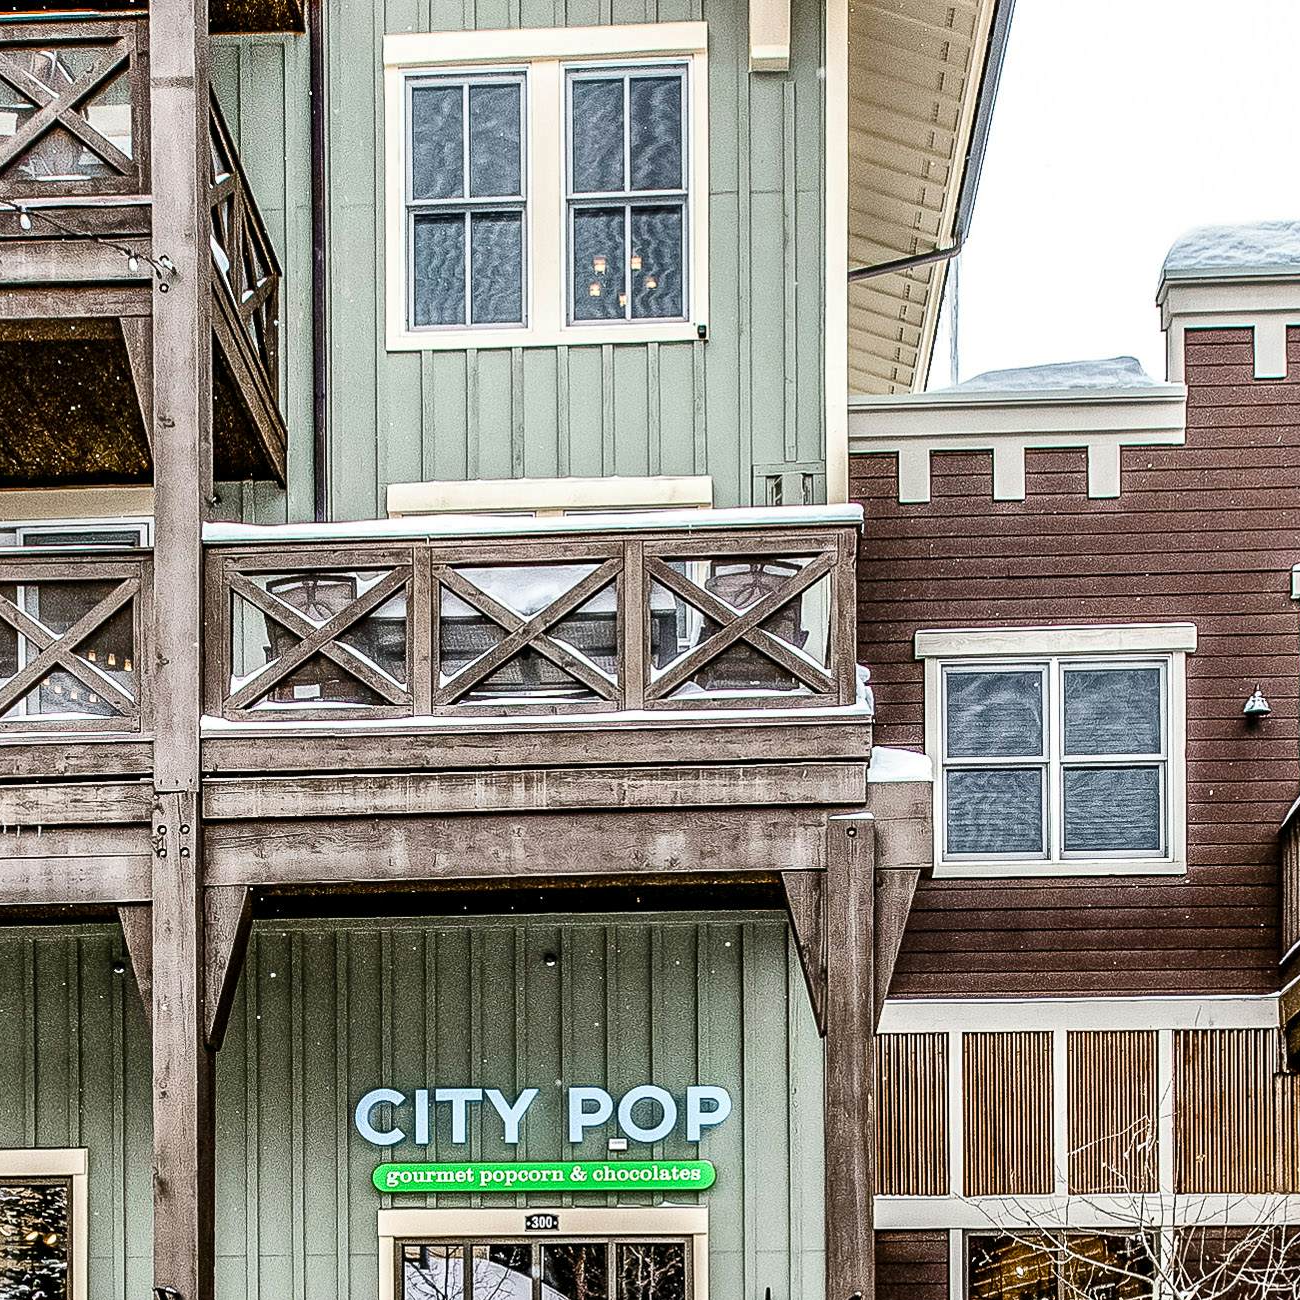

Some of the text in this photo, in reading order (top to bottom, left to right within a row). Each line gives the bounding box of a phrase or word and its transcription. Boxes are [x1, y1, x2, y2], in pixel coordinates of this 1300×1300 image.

[354, 1084, 733, 1146] CITY POP
[386, 1165, 702, 1187] gourmet popcorn & chocolates
[531, 1216, 554, 1229] 300
